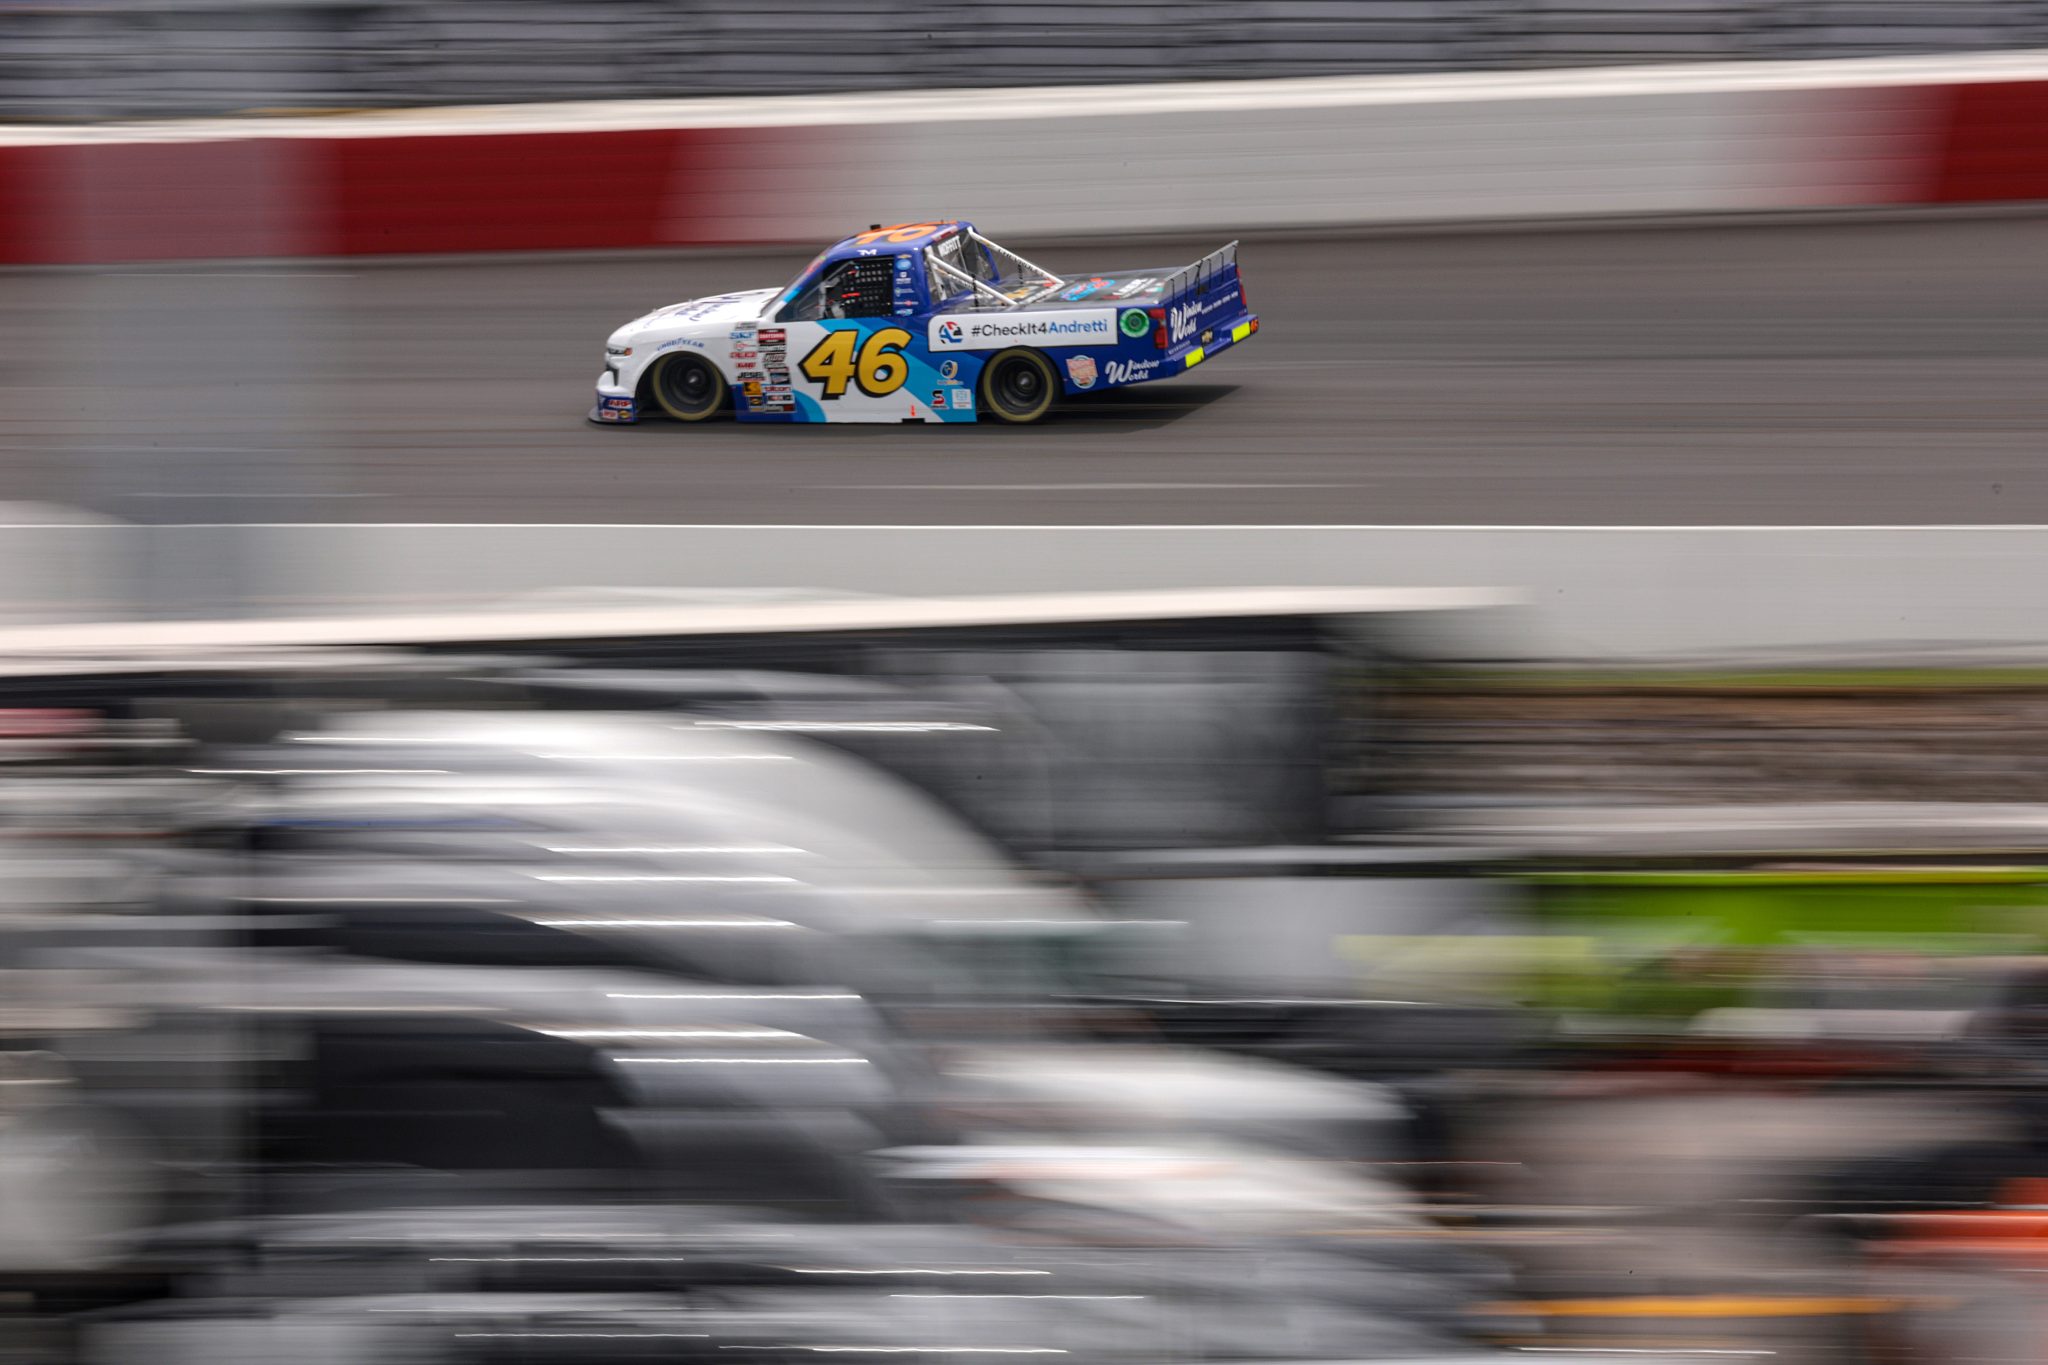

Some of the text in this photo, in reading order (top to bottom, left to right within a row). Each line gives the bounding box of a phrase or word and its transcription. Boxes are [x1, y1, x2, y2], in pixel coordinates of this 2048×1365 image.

[971, 319, 1108, 337] #CheckIt4Andretti
[798, 327, 913, 400] 46
[1104, 359, 1160, 384] Window
